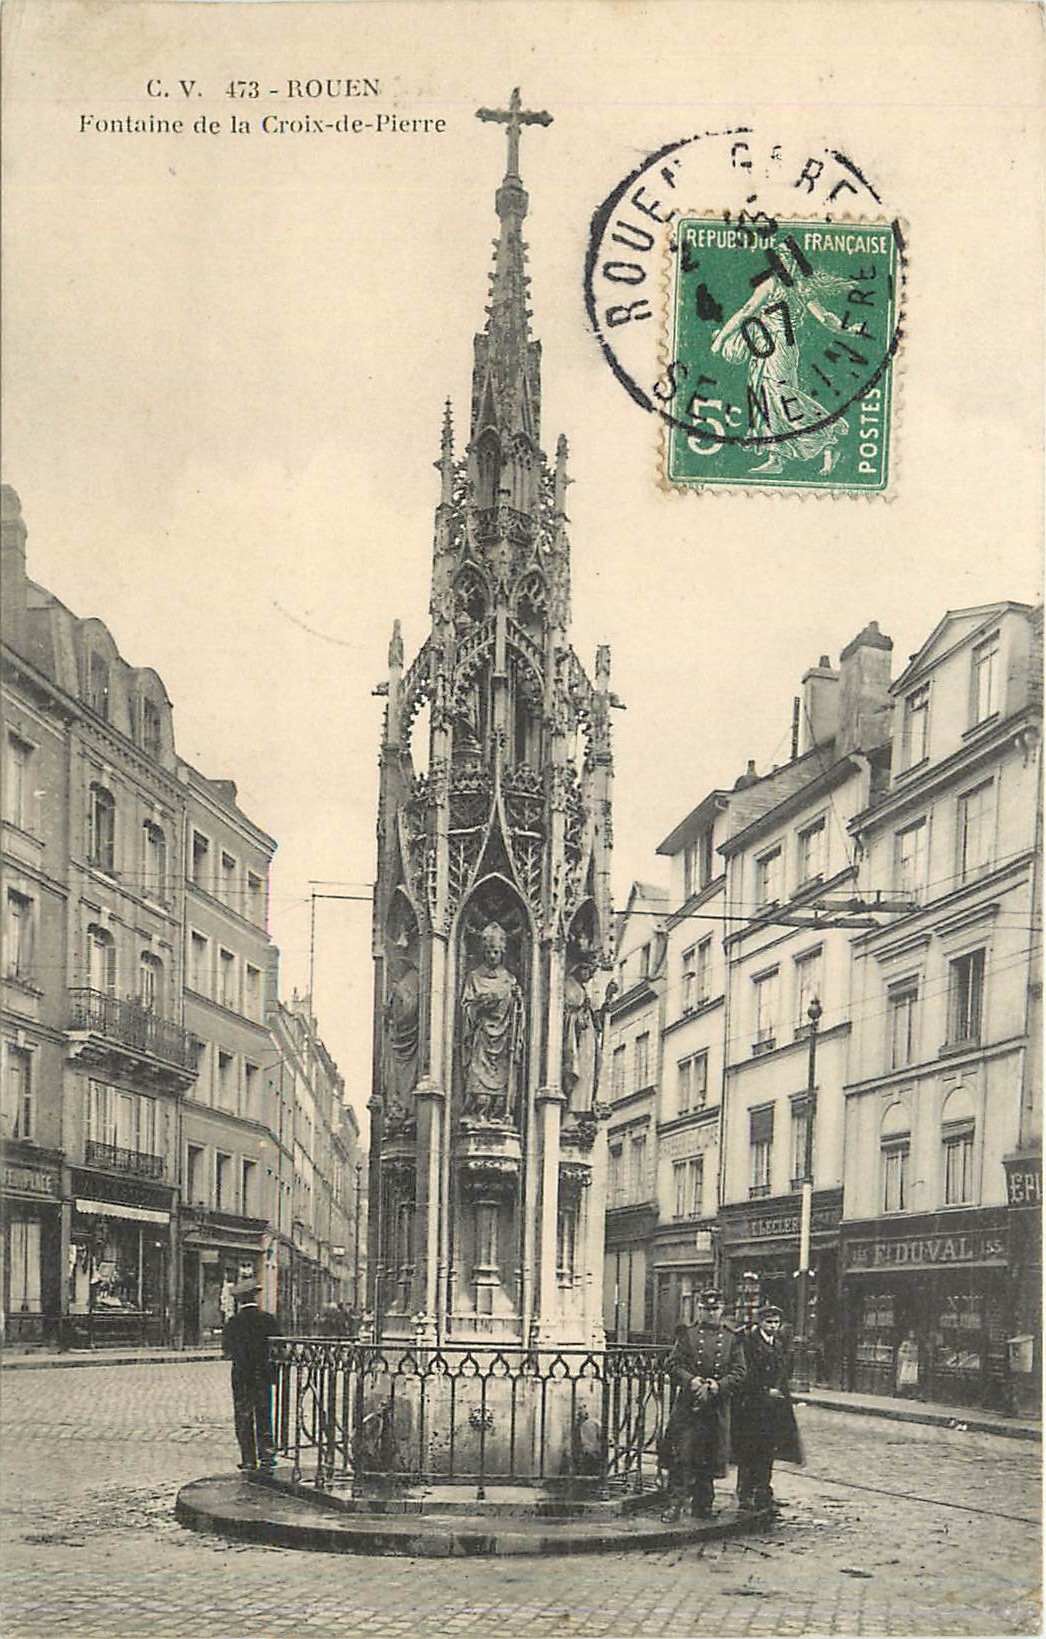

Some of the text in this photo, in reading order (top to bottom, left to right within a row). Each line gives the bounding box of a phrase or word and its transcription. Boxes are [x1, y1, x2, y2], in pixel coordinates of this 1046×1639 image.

[804, 233, 888, 256] FRANÇAISE
[740, 300, 795, 361] 07
[858, 387, 882, 475] POSTES
[894, 1237, 974, 1264] DUVAL
